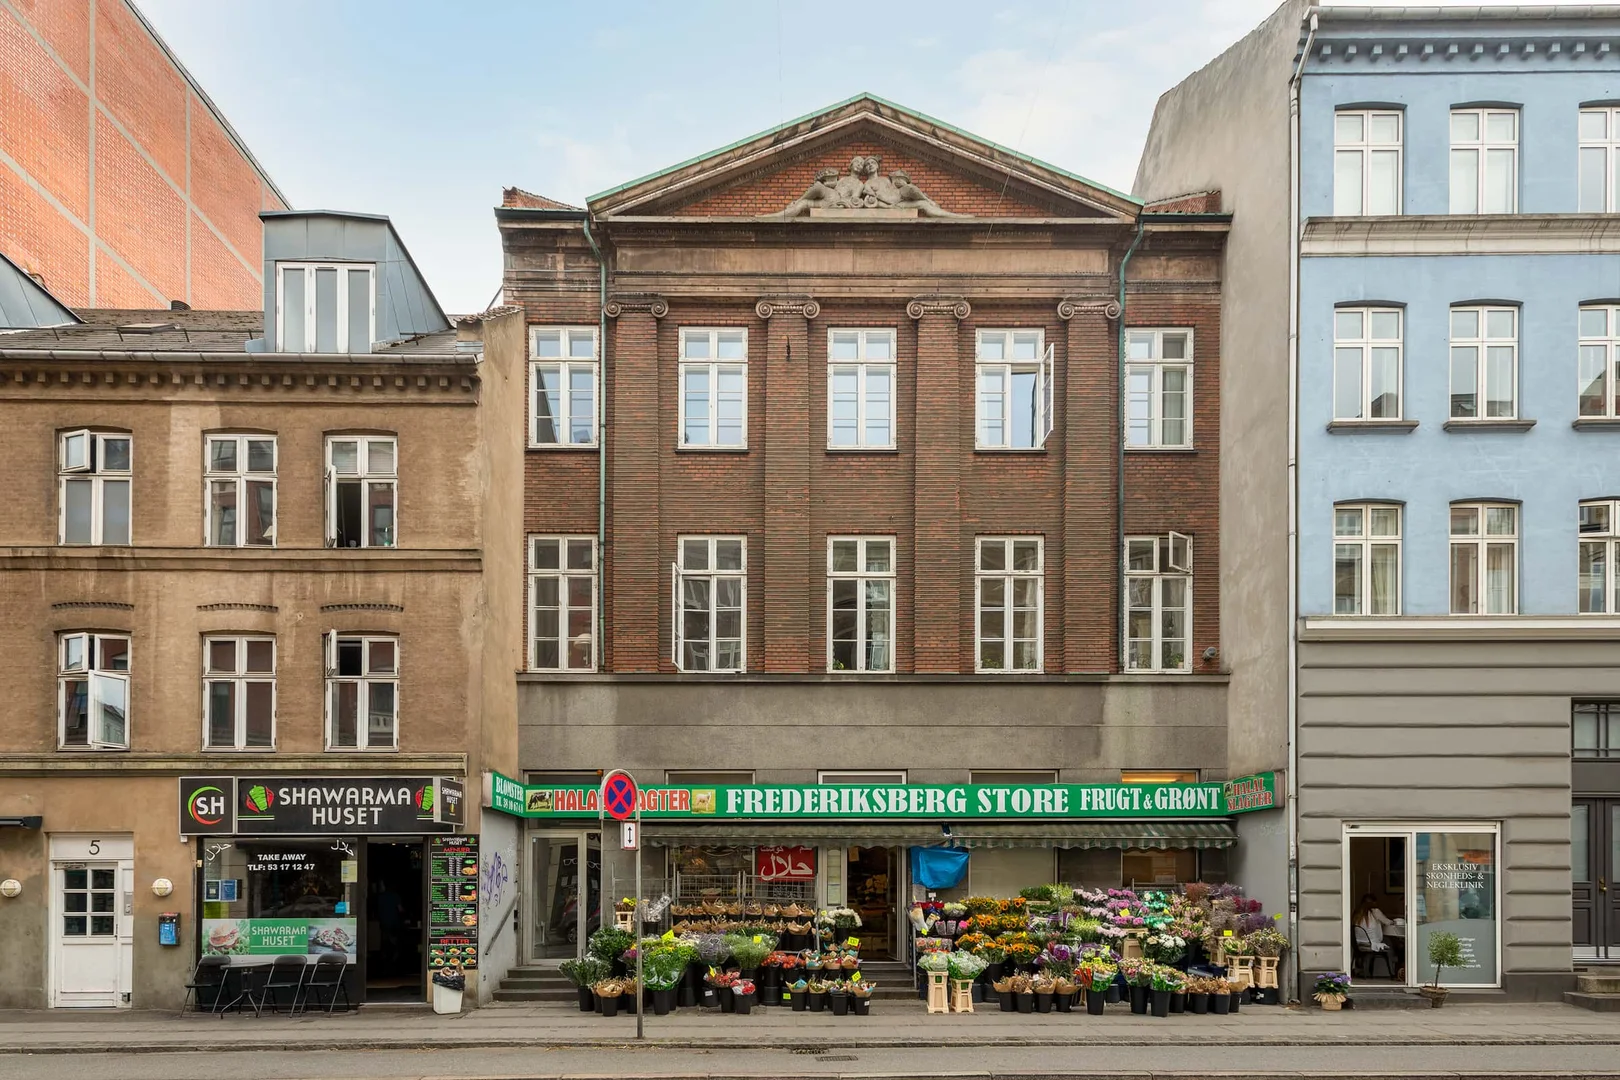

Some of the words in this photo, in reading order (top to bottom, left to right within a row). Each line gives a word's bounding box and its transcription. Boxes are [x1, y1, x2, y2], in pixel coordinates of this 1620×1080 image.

[278, 787, 411, 806] SHAWARMA
[495, 776, 523, 802] BLOMSTER
[1233, 777, 1266, 797] HALAL
[196, 796, 224, 815] S.H
[554, 789, 608, 811] HALA
[635, 789, 690, 811] AGTER
[725, 788, 967, 814] FREDERIKSBERG
[977, 787, 1069, 814] STORE
[1080, 788, 1142, 811] FRUGT
[1143, 793, 1153, 810] &
[1154, 787, 1220, 810] GRØNT
[1228, 791, 1272, 812] SLAGTER
[312, 807, 383, 825] HUSET
[88, 839, 100, 856] 5
[761, 853, 812, 881] حلال
[1426, 872, 1476, 880] SKØNHEDS-
[1477, 872, 1484, 880] &
[1432, 863, 1479, 871] EKSKLUSIV
[1426, 881, 1484, 889] NEGLEKLINIK
[251, 925, 307, 935] SHAWARMA
[262, 936, 295, 946] HUSET
